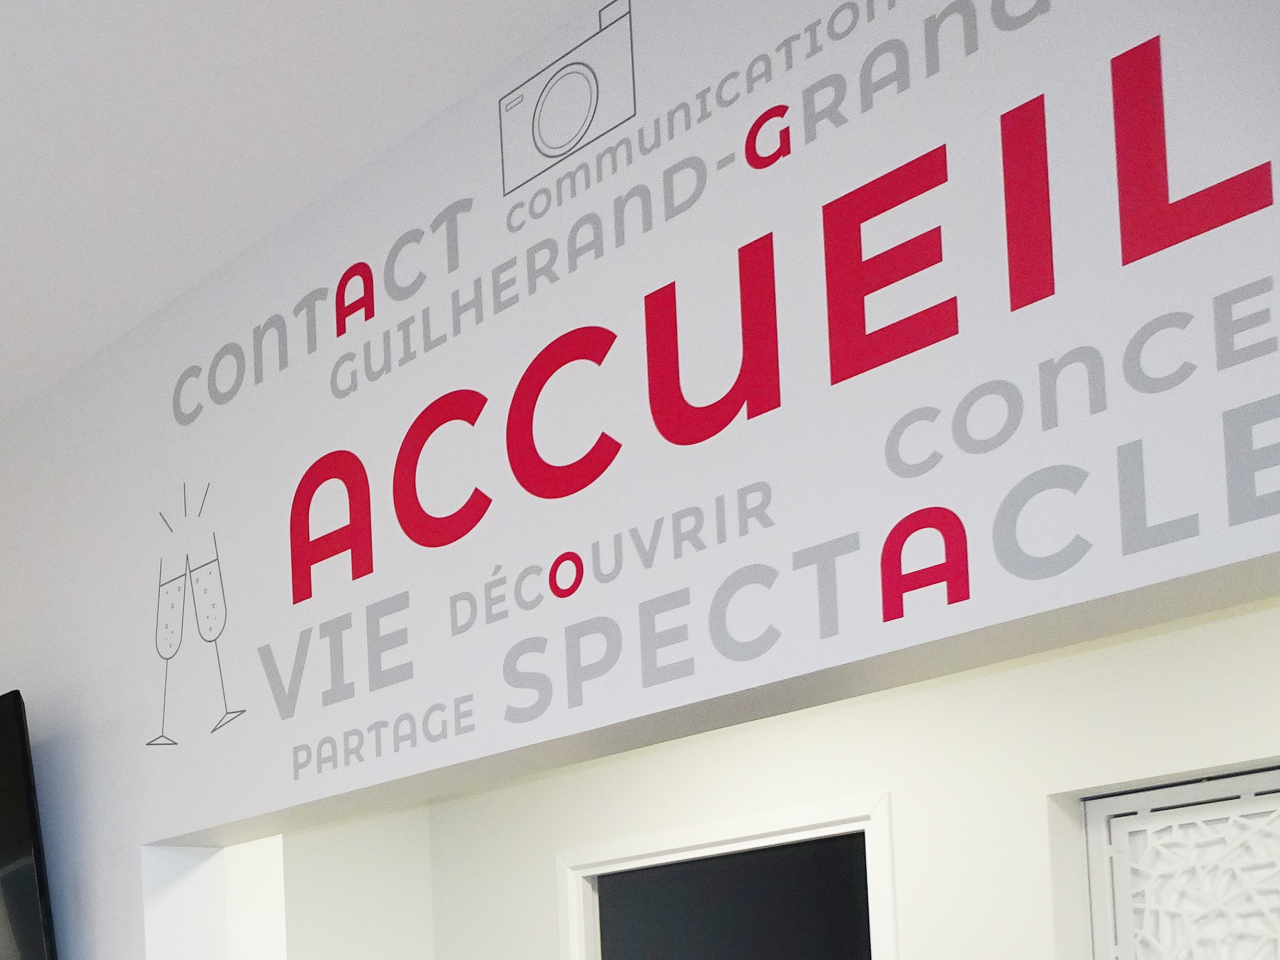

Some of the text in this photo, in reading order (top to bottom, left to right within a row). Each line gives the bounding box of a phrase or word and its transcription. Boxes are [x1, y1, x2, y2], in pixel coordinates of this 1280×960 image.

[172, 198, 473, 427] CONTACT
[290, 35, 1274, 606] ACCUEIL
[884, 275, 1279, 479] CONCE
[257, 591, 414, 722] VIE
[450, 481, 775, 636] DÉCOUVRIR
[503, 393, 1280, 724] SPECTACLE
[292, 694, 475, 780] PARTAGE
